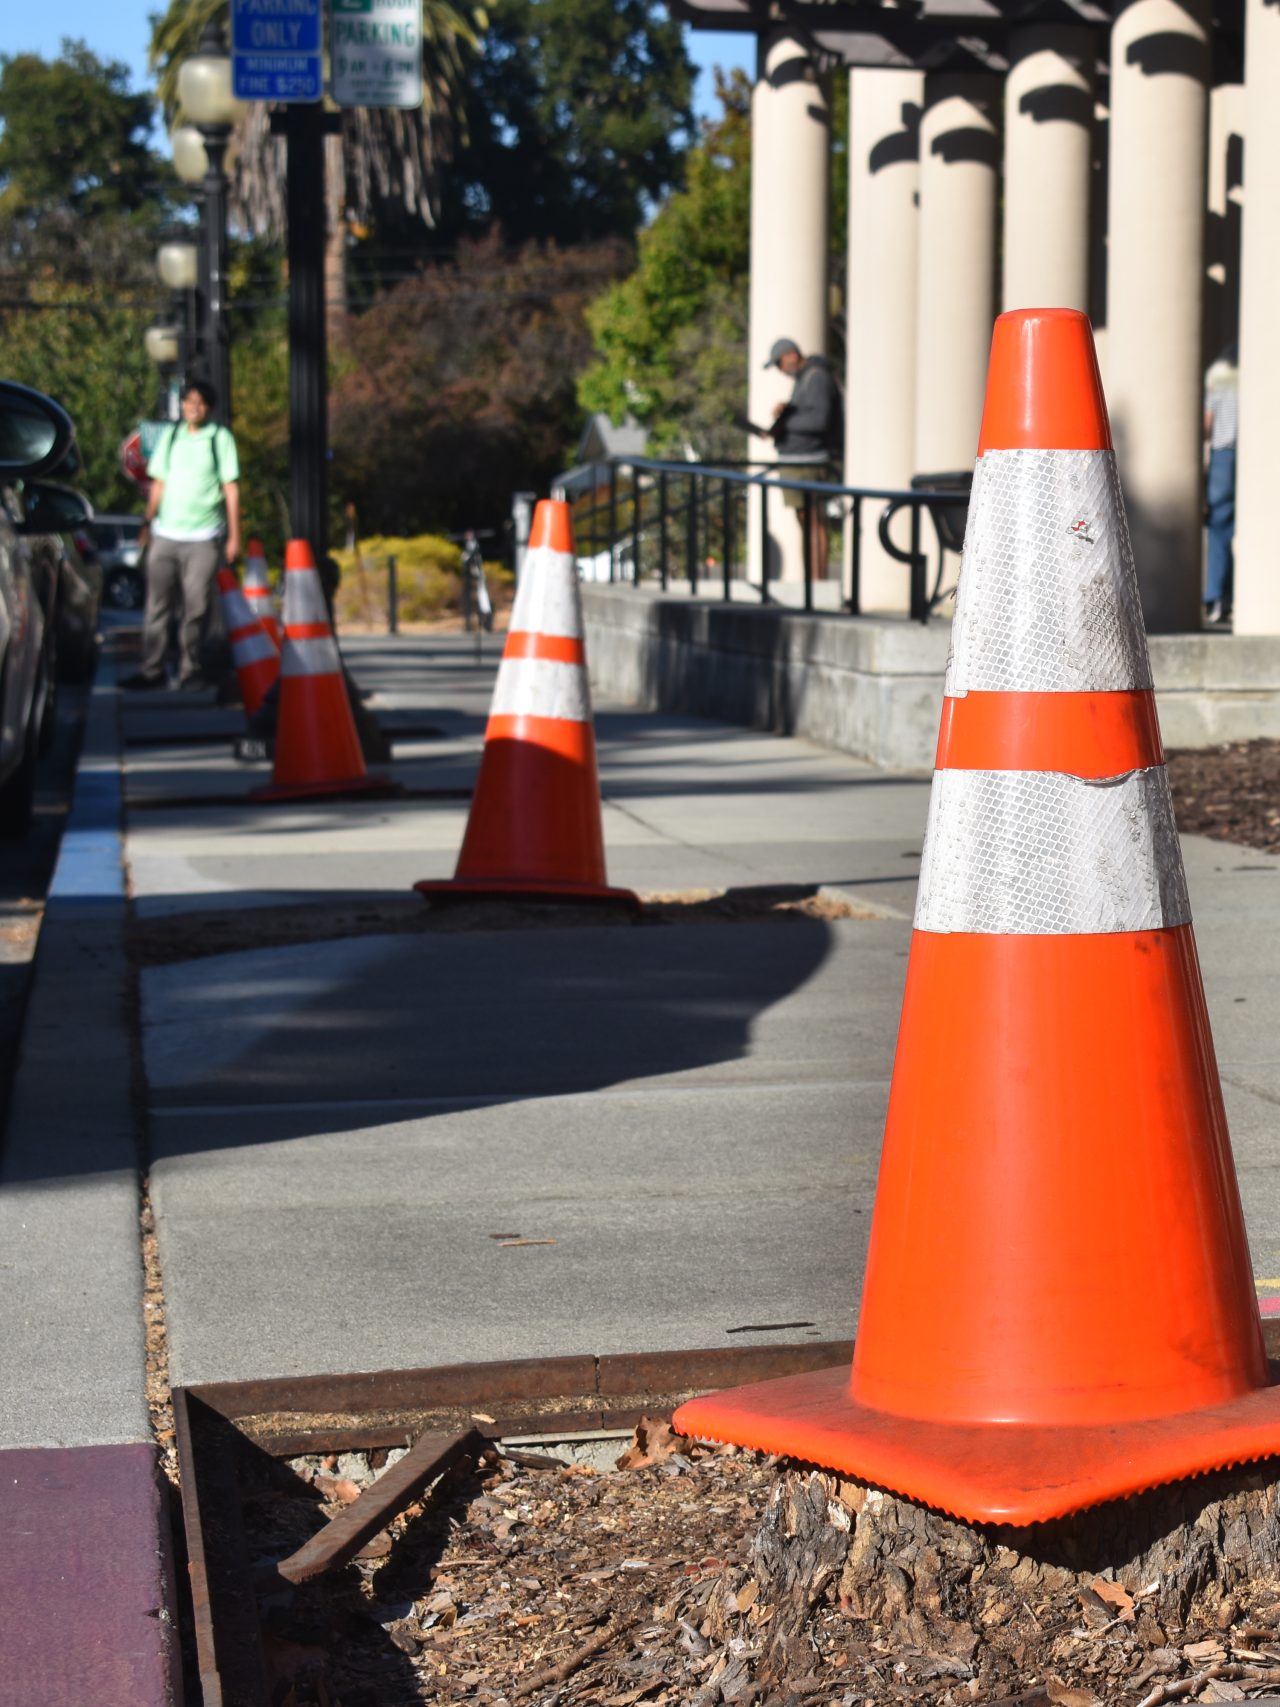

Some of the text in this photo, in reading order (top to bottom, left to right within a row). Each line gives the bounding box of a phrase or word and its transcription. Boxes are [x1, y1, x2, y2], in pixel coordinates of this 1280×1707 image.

[236, 0, 317, 16] PARKING
[250, 20, 303, 47] ONLY
[335, 20, 415, 48] PARKING
[246, 57, 309, 73] MINIMUM
[239, 76, 269, 93] FINE
